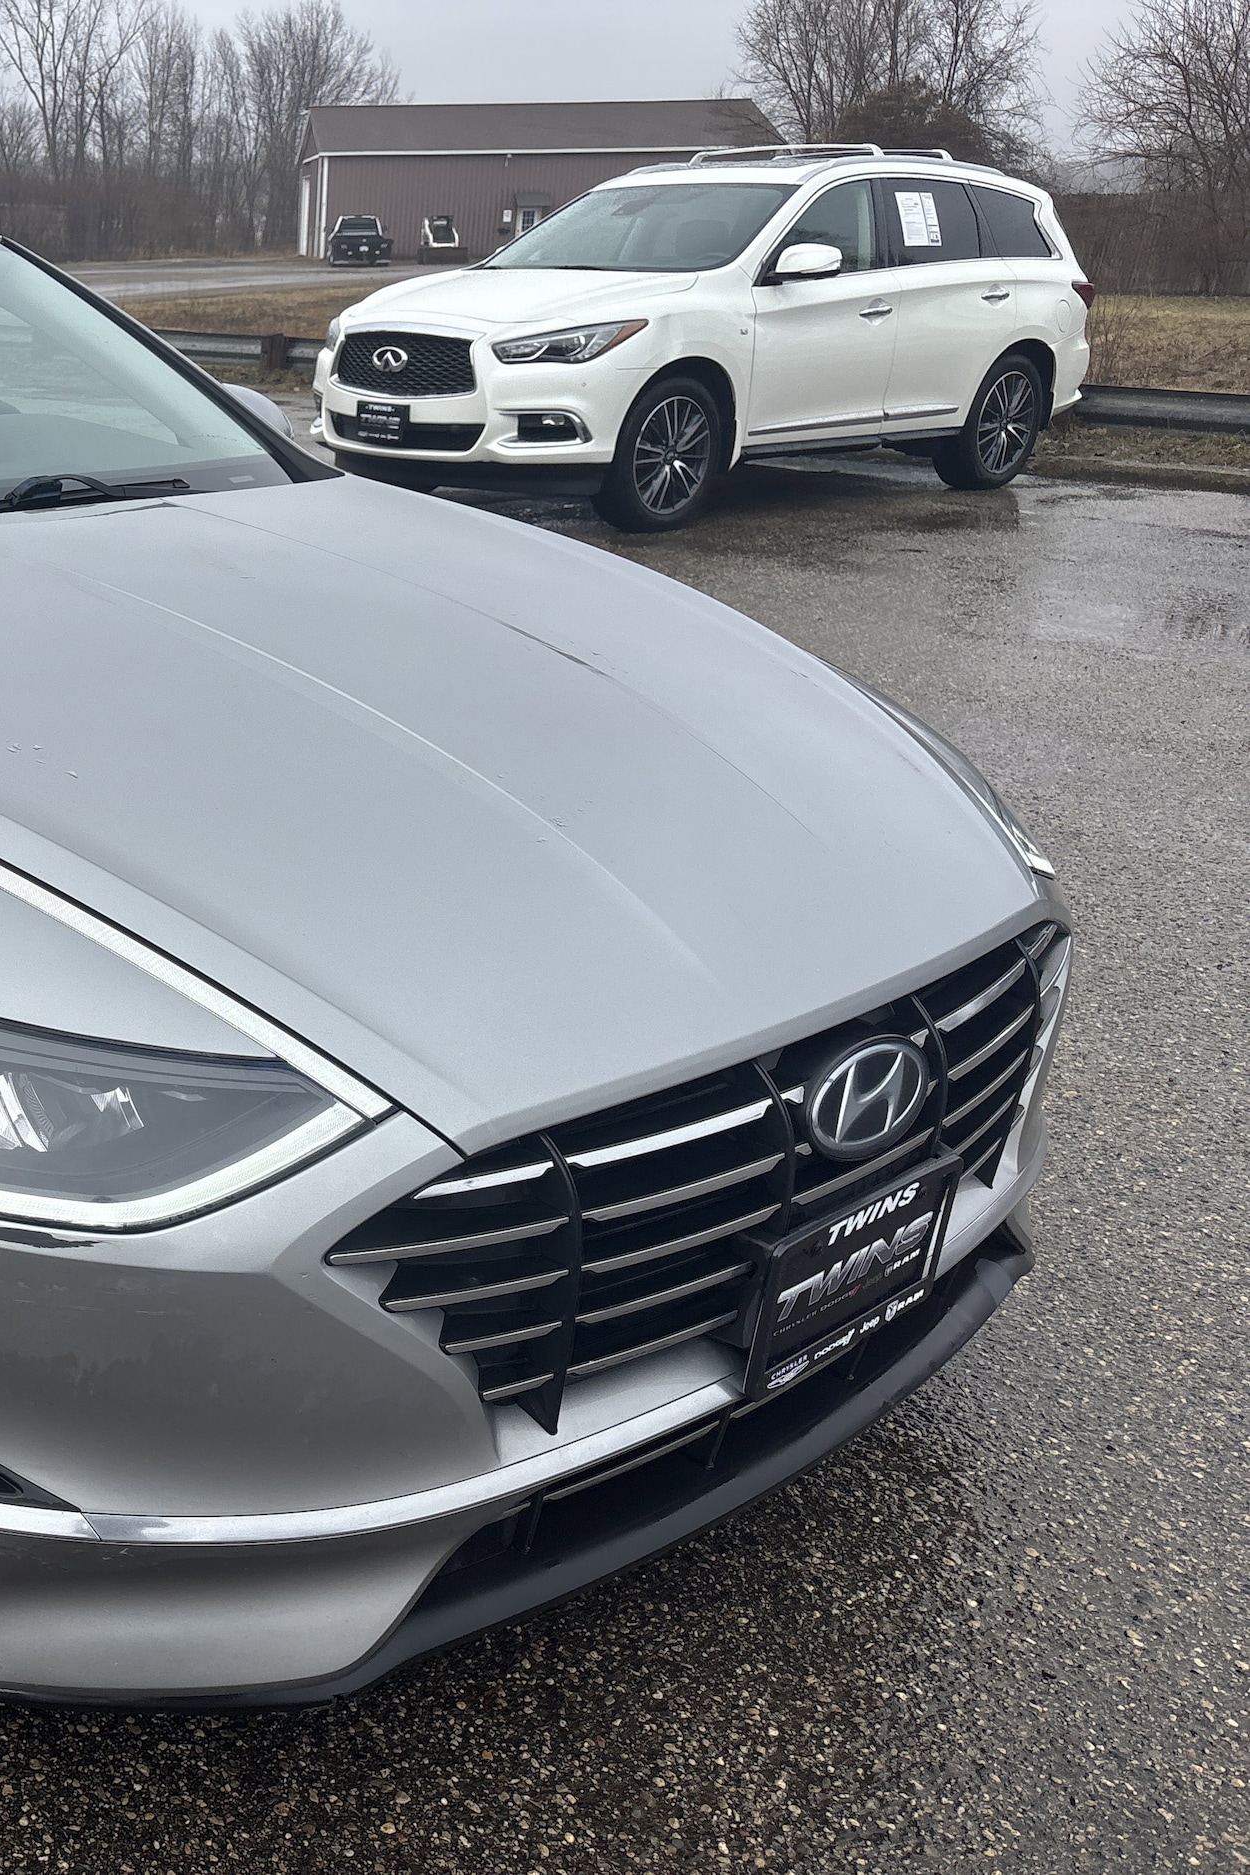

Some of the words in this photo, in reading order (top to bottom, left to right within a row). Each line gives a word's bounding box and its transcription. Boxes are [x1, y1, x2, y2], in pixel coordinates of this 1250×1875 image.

[827, 1181, 920, 1247] TWINS
[773, 1310, 817, 1337] CHRYSLER
[892, 1248, 921, 1271] RAM
[776, 1210, 934, 1323] TWINS
[771, 1354, 809, 1381] CHRYSLER
[859, 1315, 881, 1335] Jeep
[896, 1288, 925, 1312] RAM
